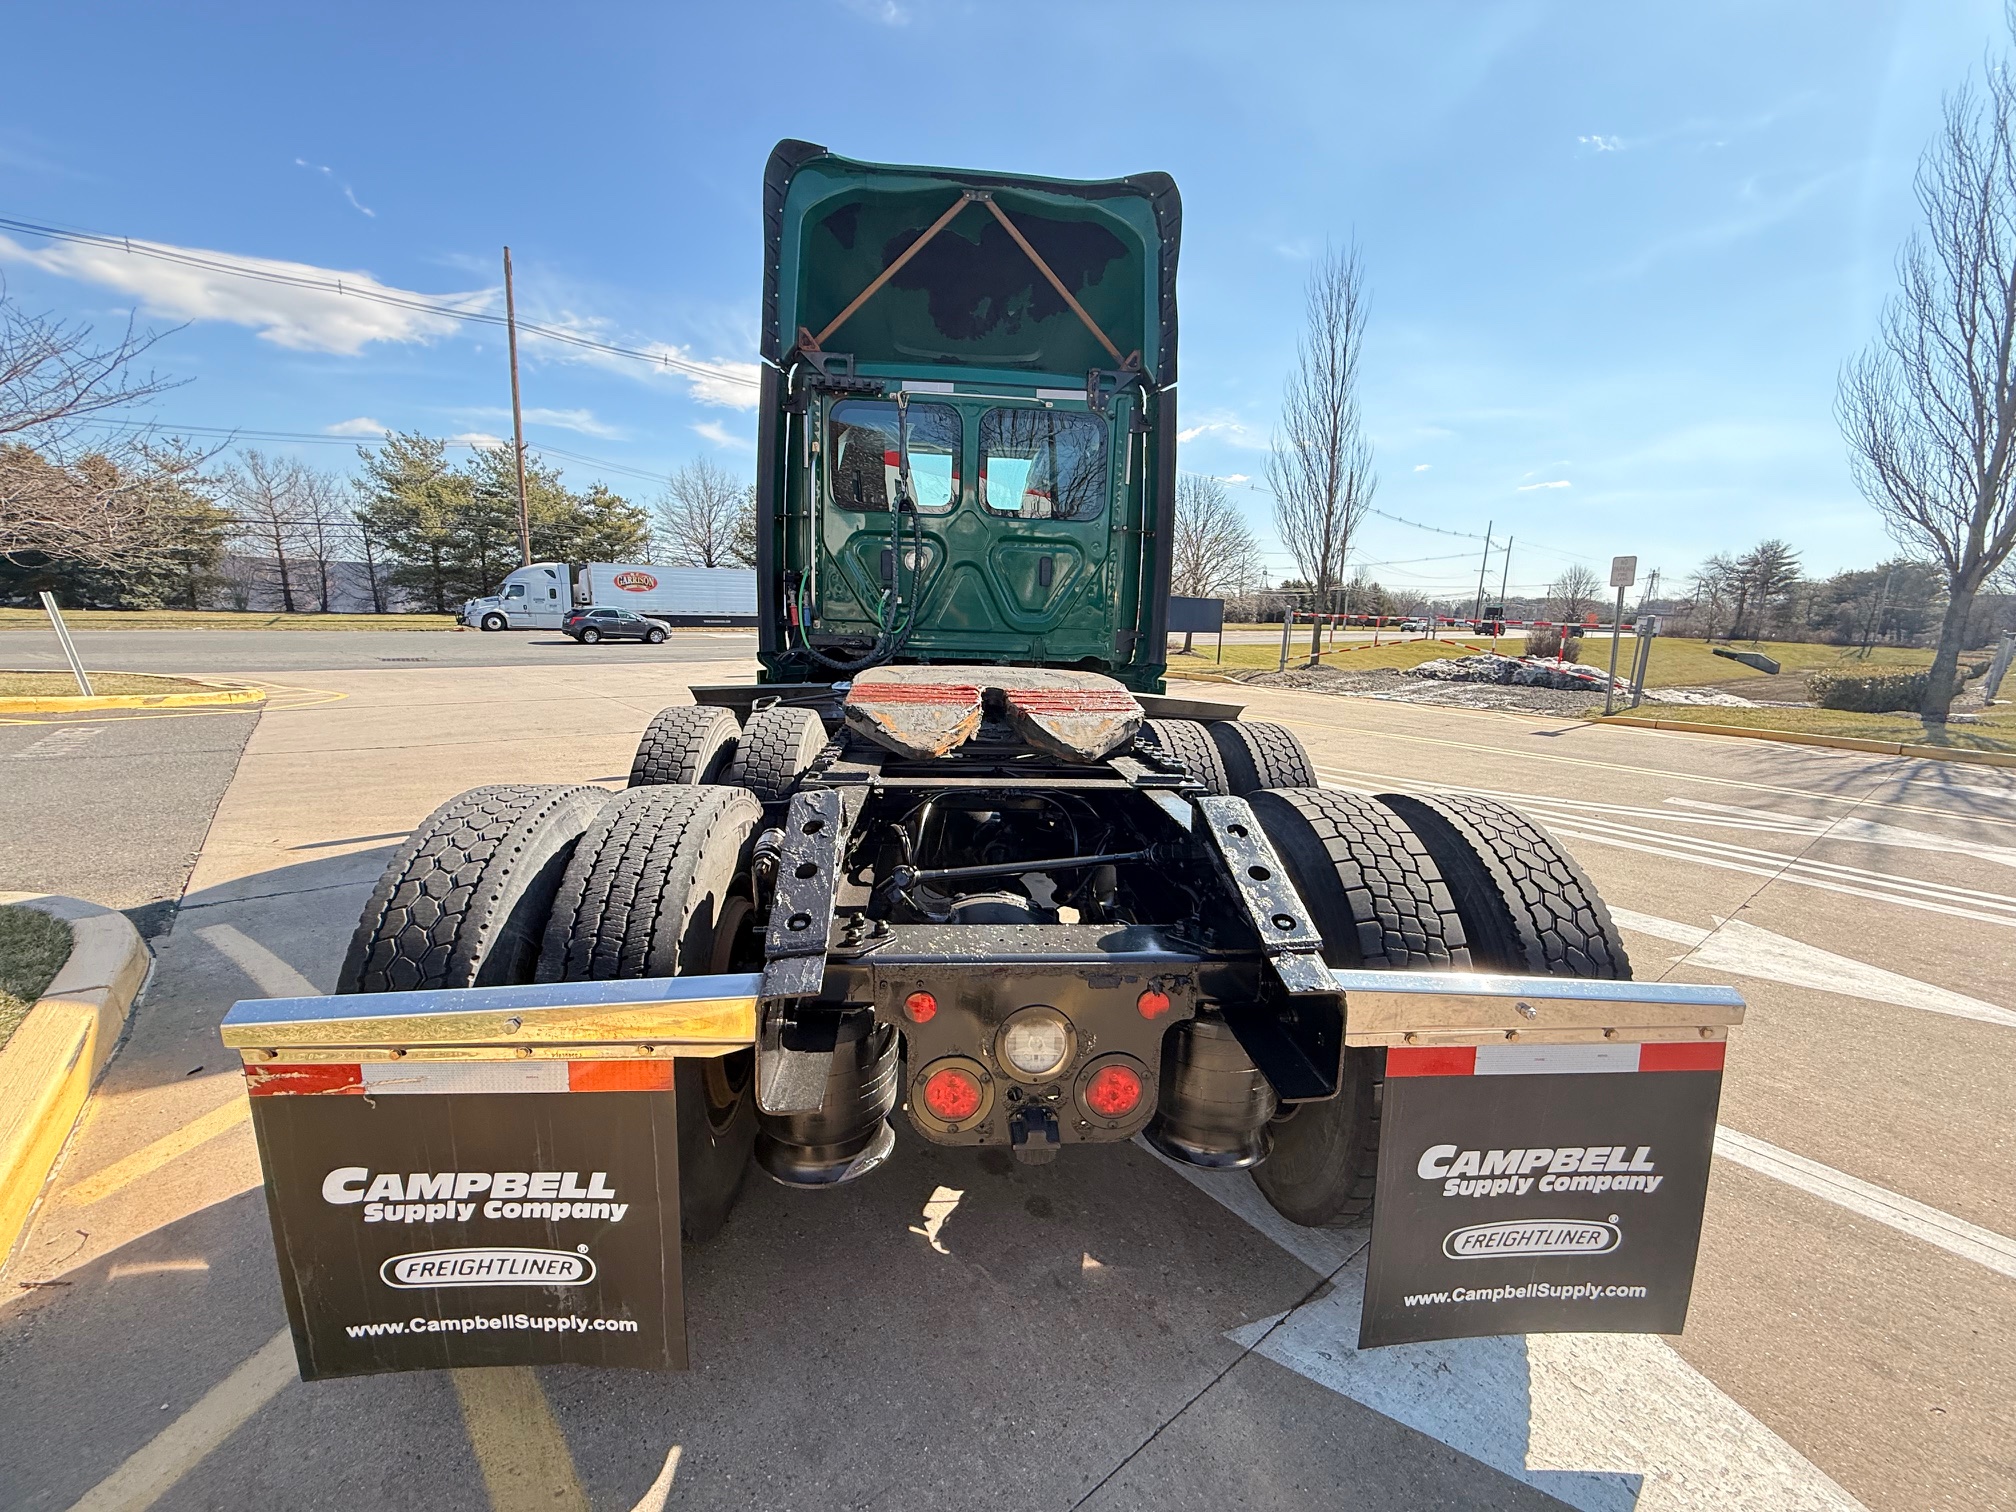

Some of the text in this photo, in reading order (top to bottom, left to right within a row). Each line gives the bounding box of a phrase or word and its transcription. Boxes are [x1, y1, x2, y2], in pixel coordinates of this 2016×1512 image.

[617, 575, 655, 587] GARRISON
[1418, 1145, 1655, 1179] CAMPBELL
[322, 1167, 616, 1204] CAMPBELL
[1443, 1175, 1664, 1197] Supply Company
[364, 1201, 629, 1223] Supply Company
[1461, 1229, 1602, 1250] FREIGHTLINER
[406, 1257, 574, 1278] FREIGHTLINER
[1404, 1283, 1647, 1307] www.CampbellSupply.com
[345, 1314, 638, 1338] www.CampbellSupply.com
